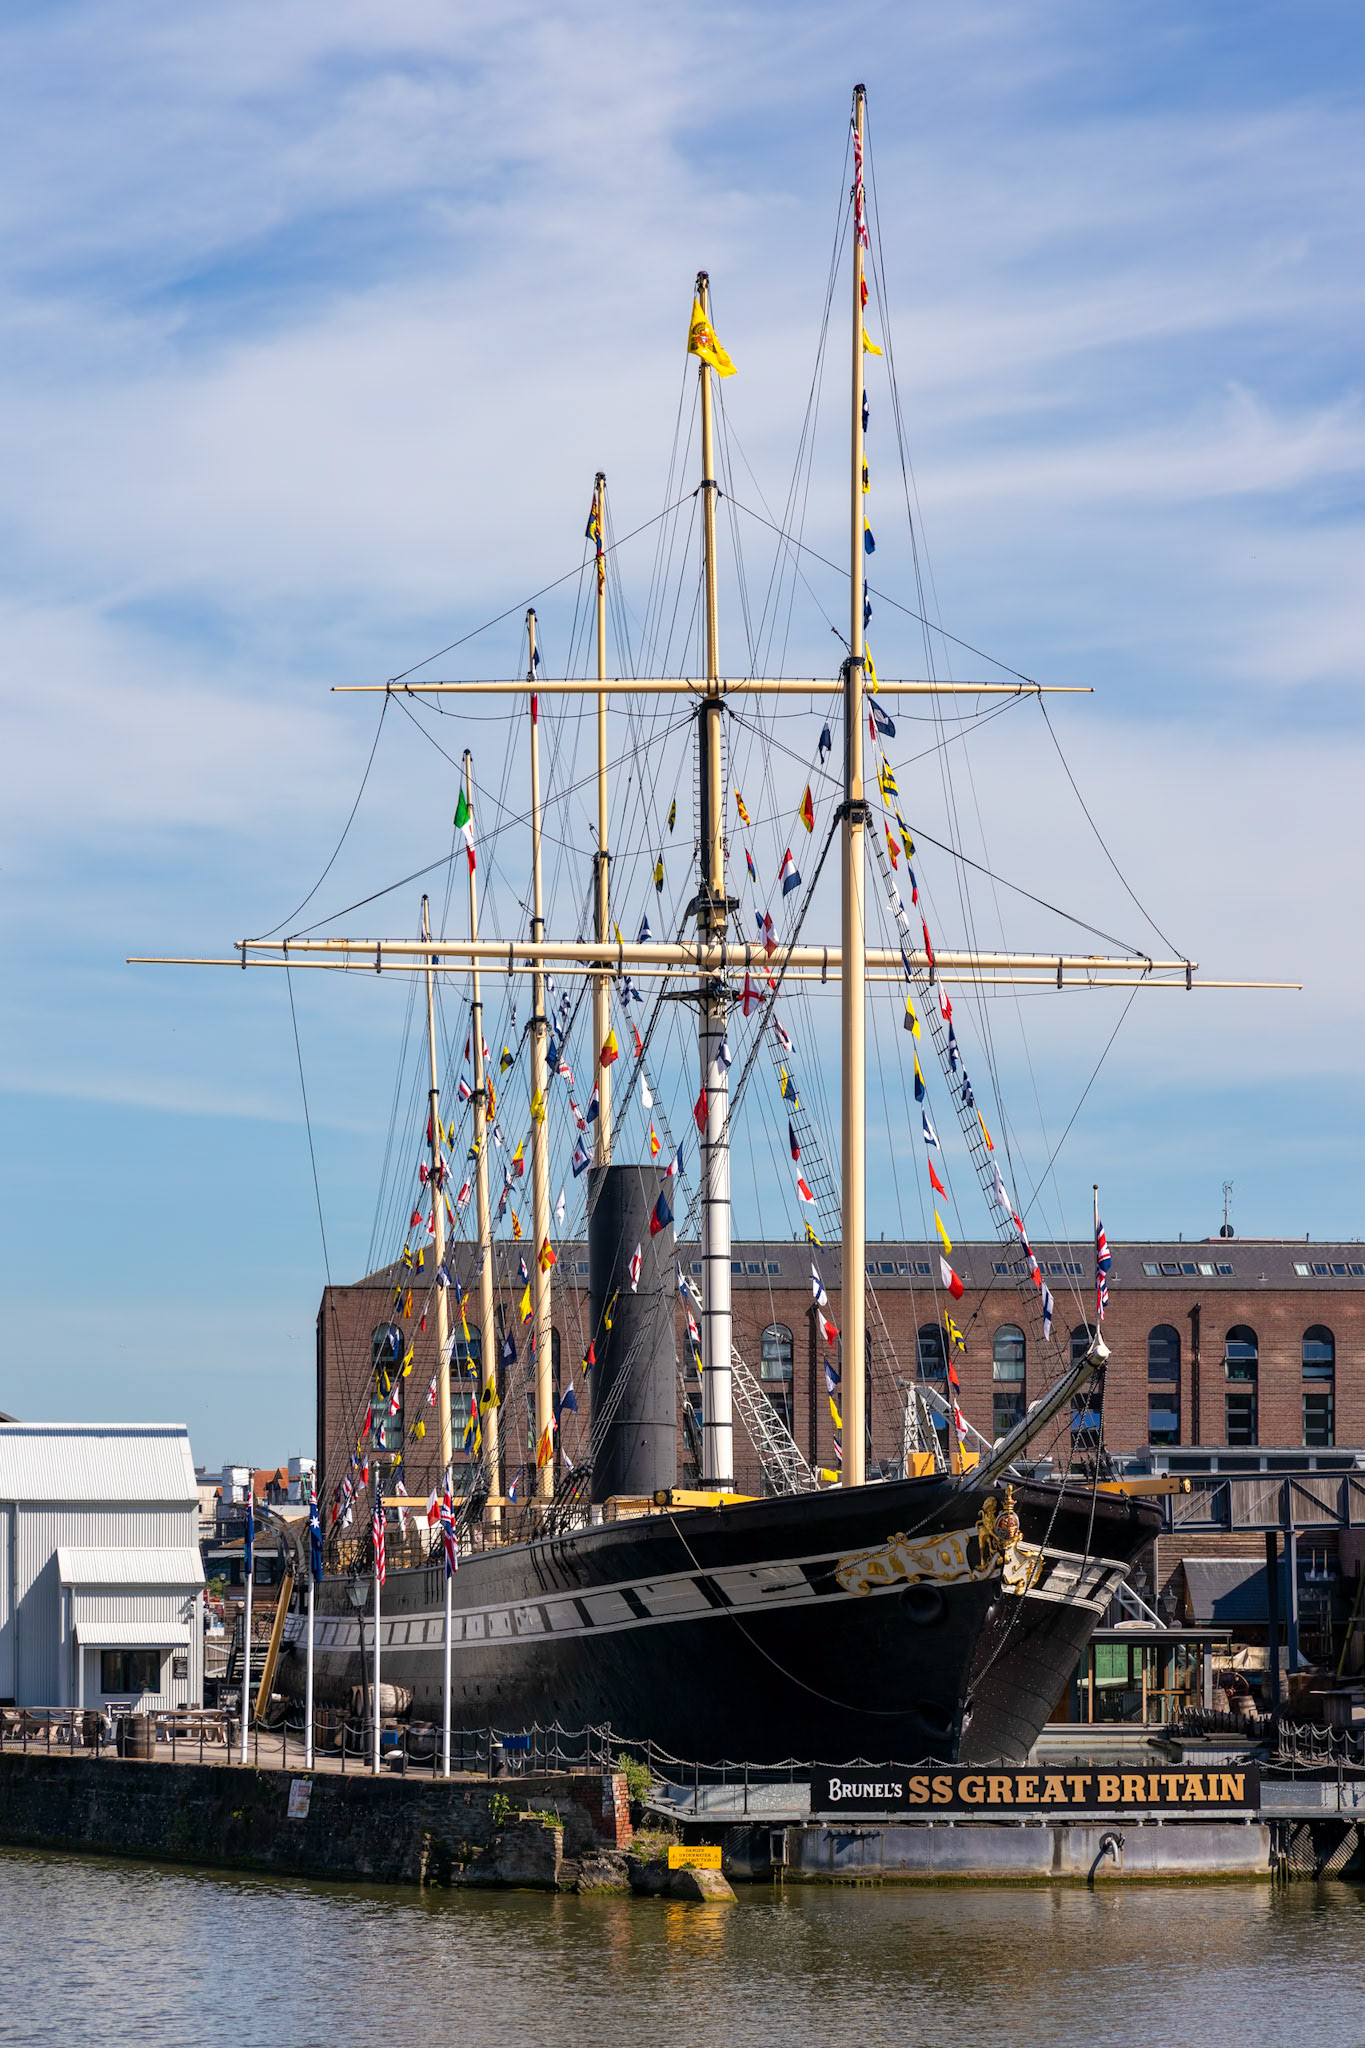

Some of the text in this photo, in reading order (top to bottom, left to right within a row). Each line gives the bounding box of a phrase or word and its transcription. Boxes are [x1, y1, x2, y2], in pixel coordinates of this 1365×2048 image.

[908, 1776, 954, 1804] SS
[957, 1775, 1092, 1804] GREAT
[1096, 1773, 1247, 1803] BRITAIN
